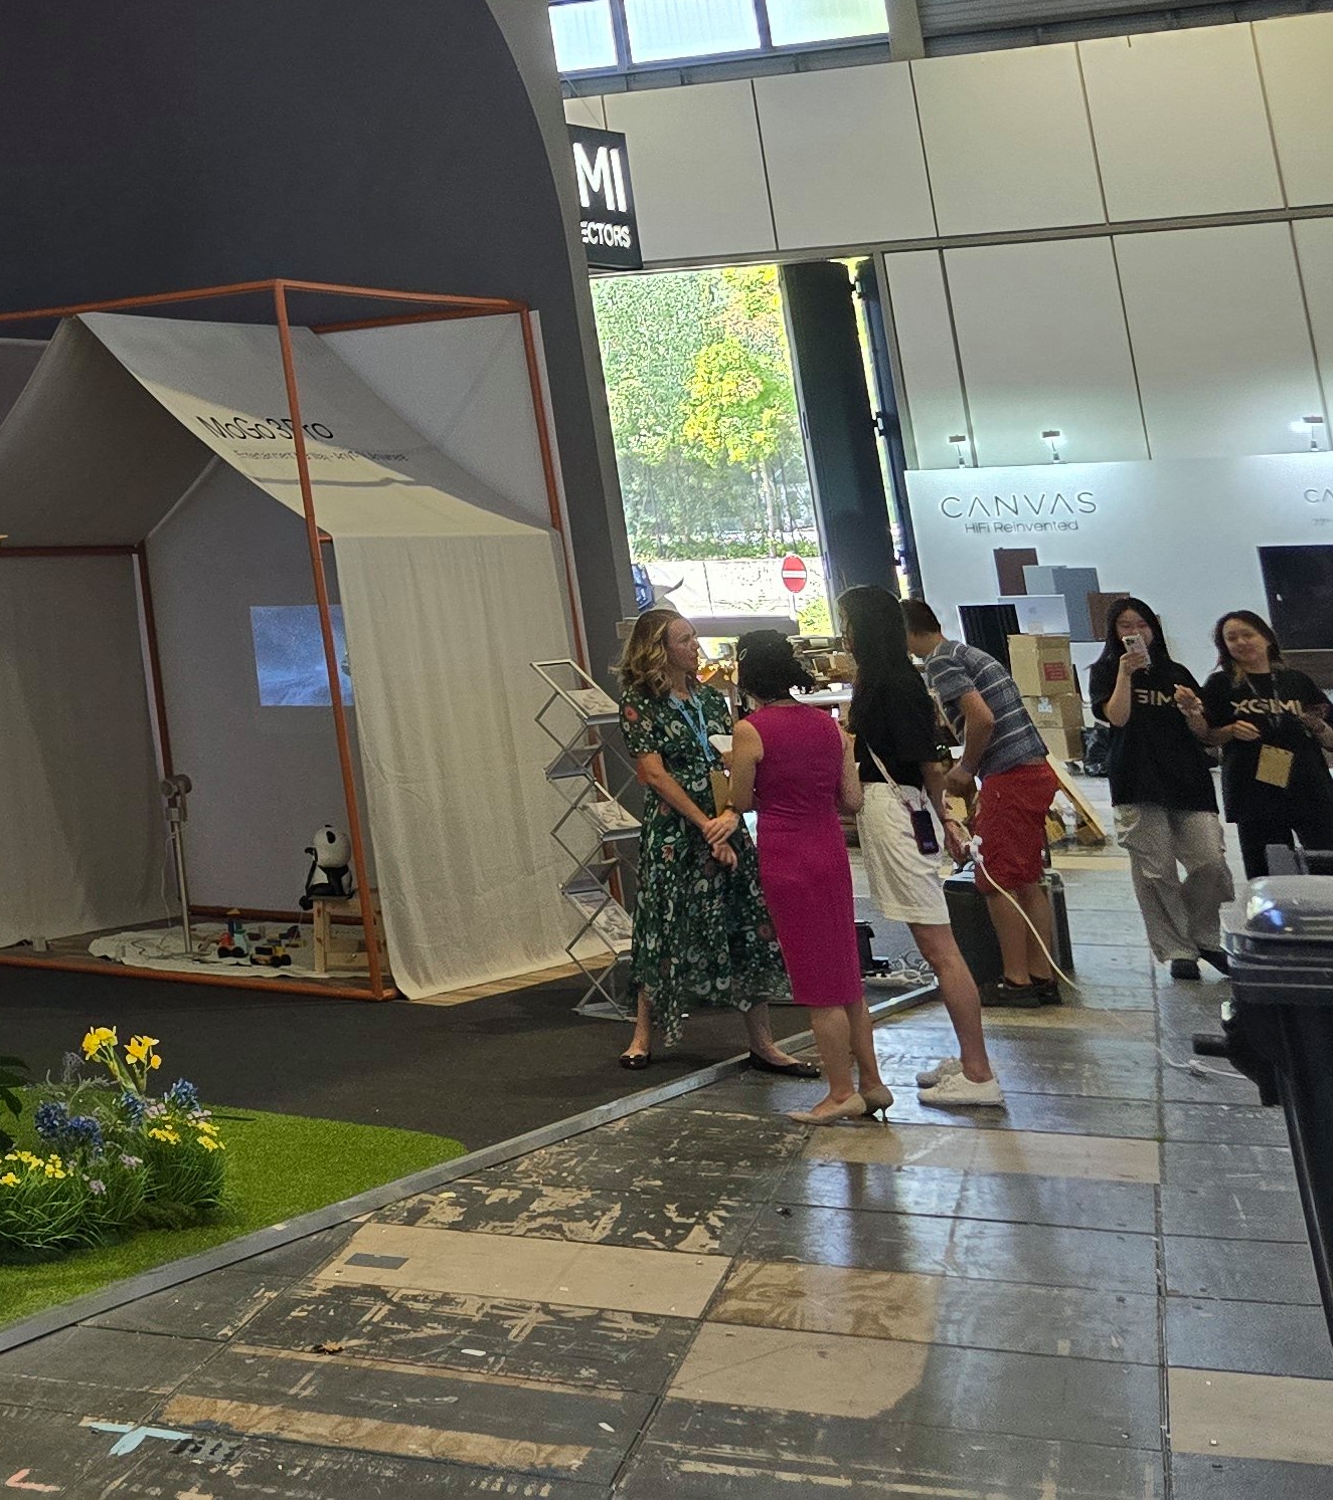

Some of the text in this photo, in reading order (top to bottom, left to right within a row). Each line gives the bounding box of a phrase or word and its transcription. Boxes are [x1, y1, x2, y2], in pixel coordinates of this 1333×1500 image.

[196, 416, 276, 439] MoGo
[941, 491, 1097, 518] CANVAS
[965, 519, 1079, 534] HiFi Reinvented
